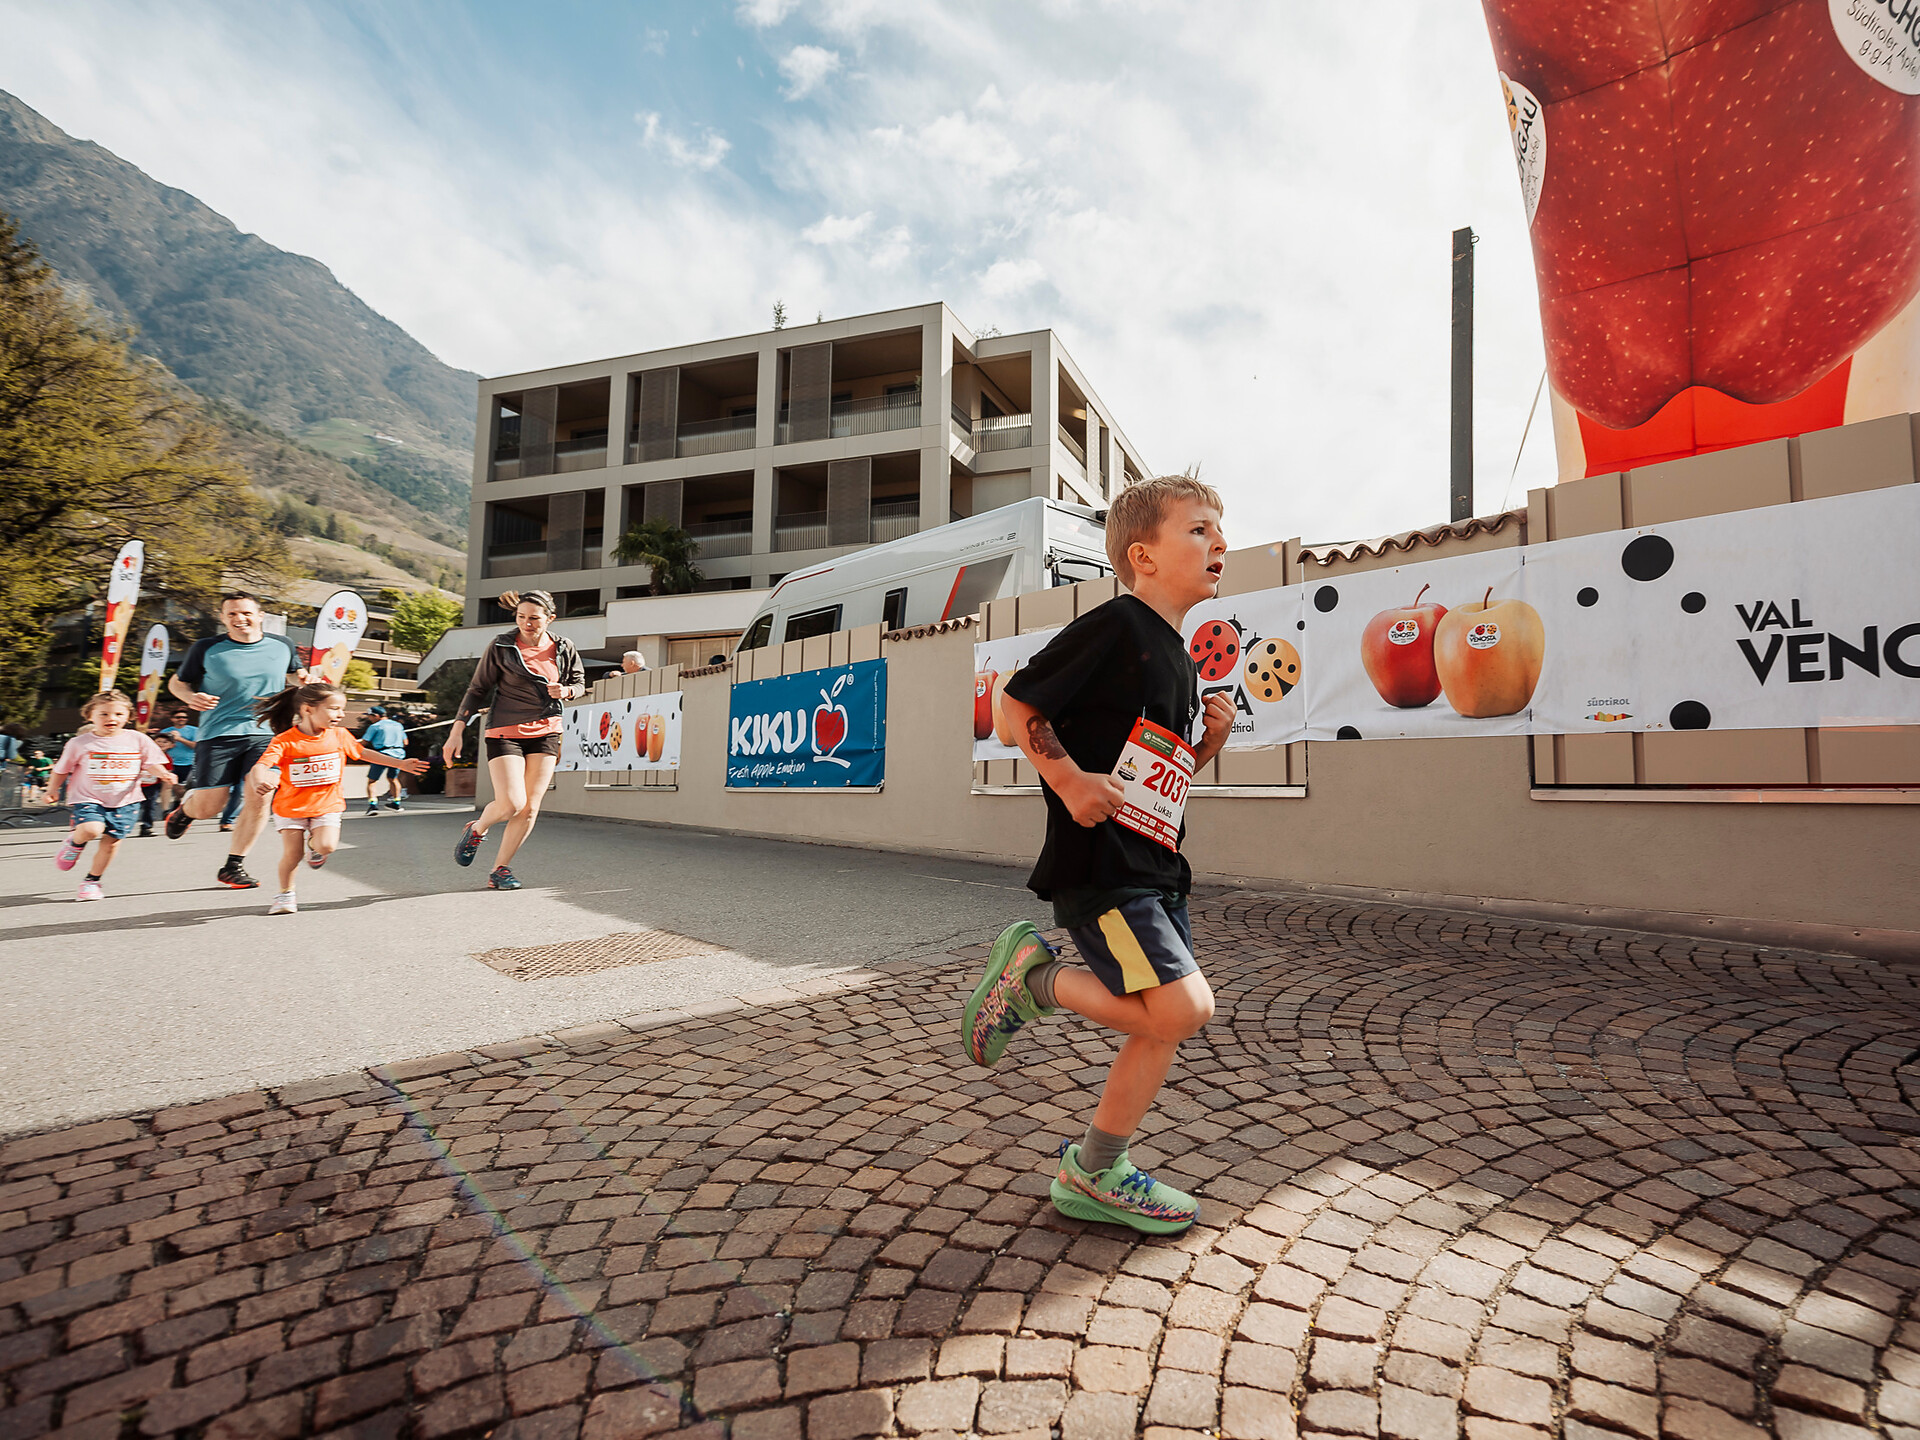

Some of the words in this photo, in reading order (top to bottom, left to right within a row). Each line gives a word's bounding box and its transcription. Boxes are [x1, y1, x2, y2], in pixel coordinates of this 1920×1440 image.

[1847, 0, 1898, 51] Südtiroler
[1734, 598, 1813, 633] VAL
[579, 742, 612, 758] VENOSTA
[730, 708, 807, 757] KIKU
[728, 765, 749, 778] Fresh
[751, 762, 775, 779] Apple
[776, 758, 805, 775] Emotion
[1142, 761, 1190, 807] 2037
[1153, 801, 1173, 819] Lukas
